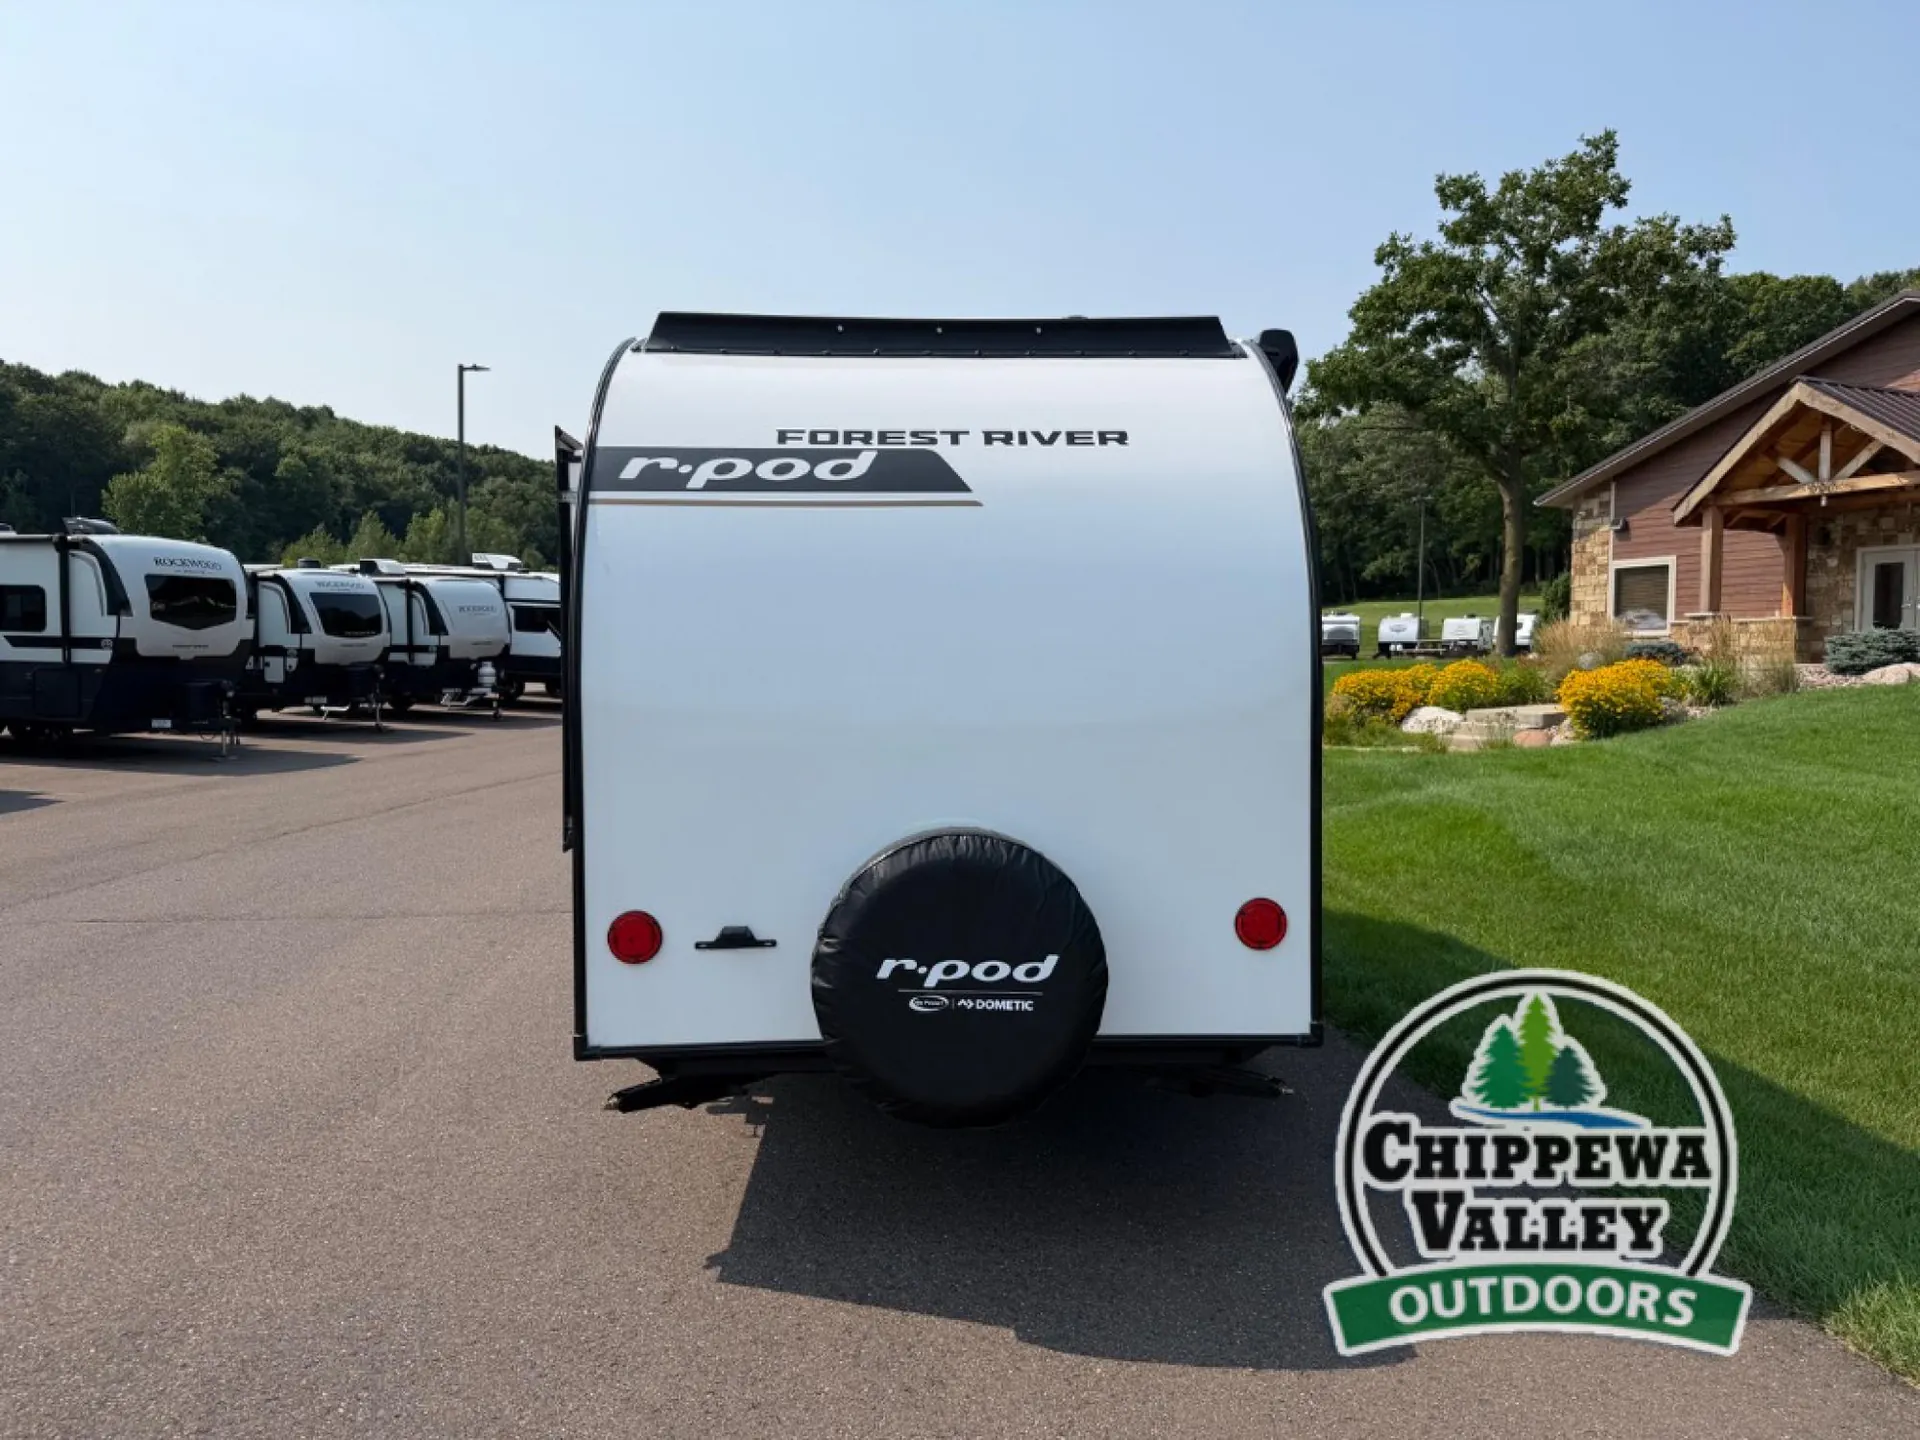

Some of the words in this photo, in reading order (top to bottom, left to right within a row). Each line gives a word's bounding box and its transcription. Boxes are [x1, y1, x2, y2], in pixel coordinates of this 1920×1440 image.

[775, 429, 970, 446] FOREST
[982, 430, 1130, 446] RIVER
[976, 999, 1034, 1012] DOMETIC
